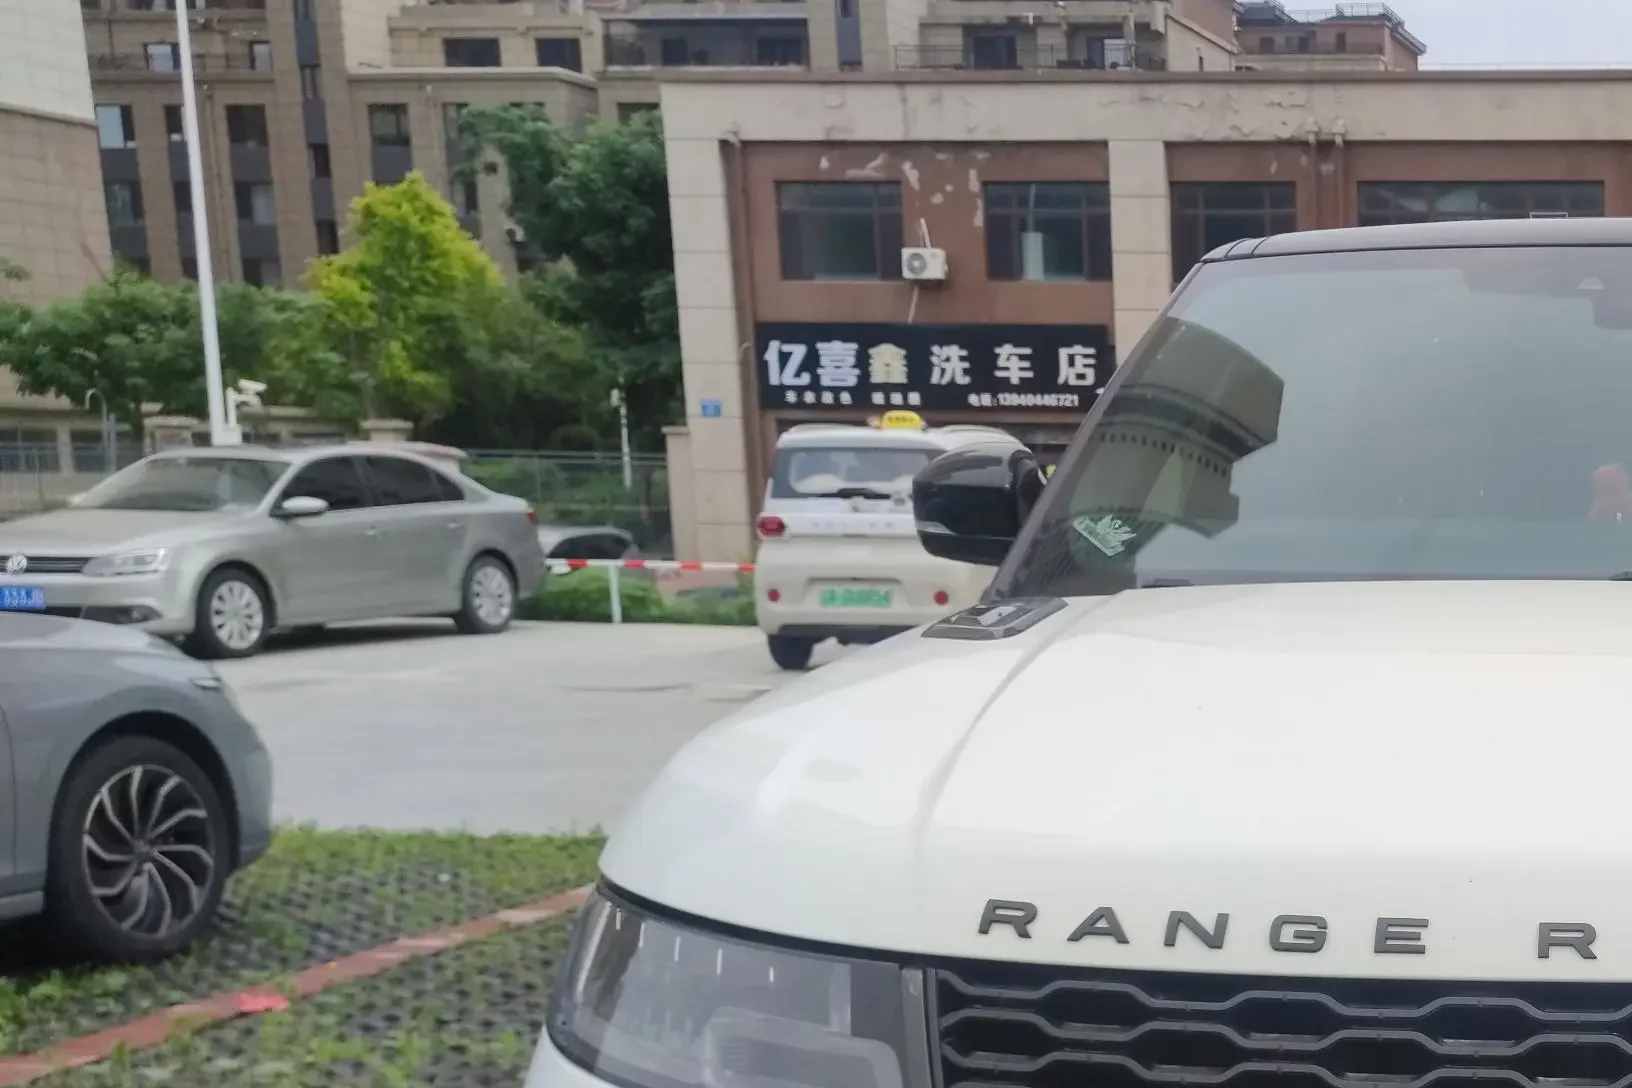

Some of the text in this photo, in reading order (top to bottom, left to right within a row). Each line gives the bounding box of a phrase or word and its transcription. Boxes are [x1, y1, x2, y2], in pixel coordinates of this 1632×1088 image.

[764, 339, 1098, 387] 亿喜鑫洗车店
[978, 898, 1431, 956] RANGE
